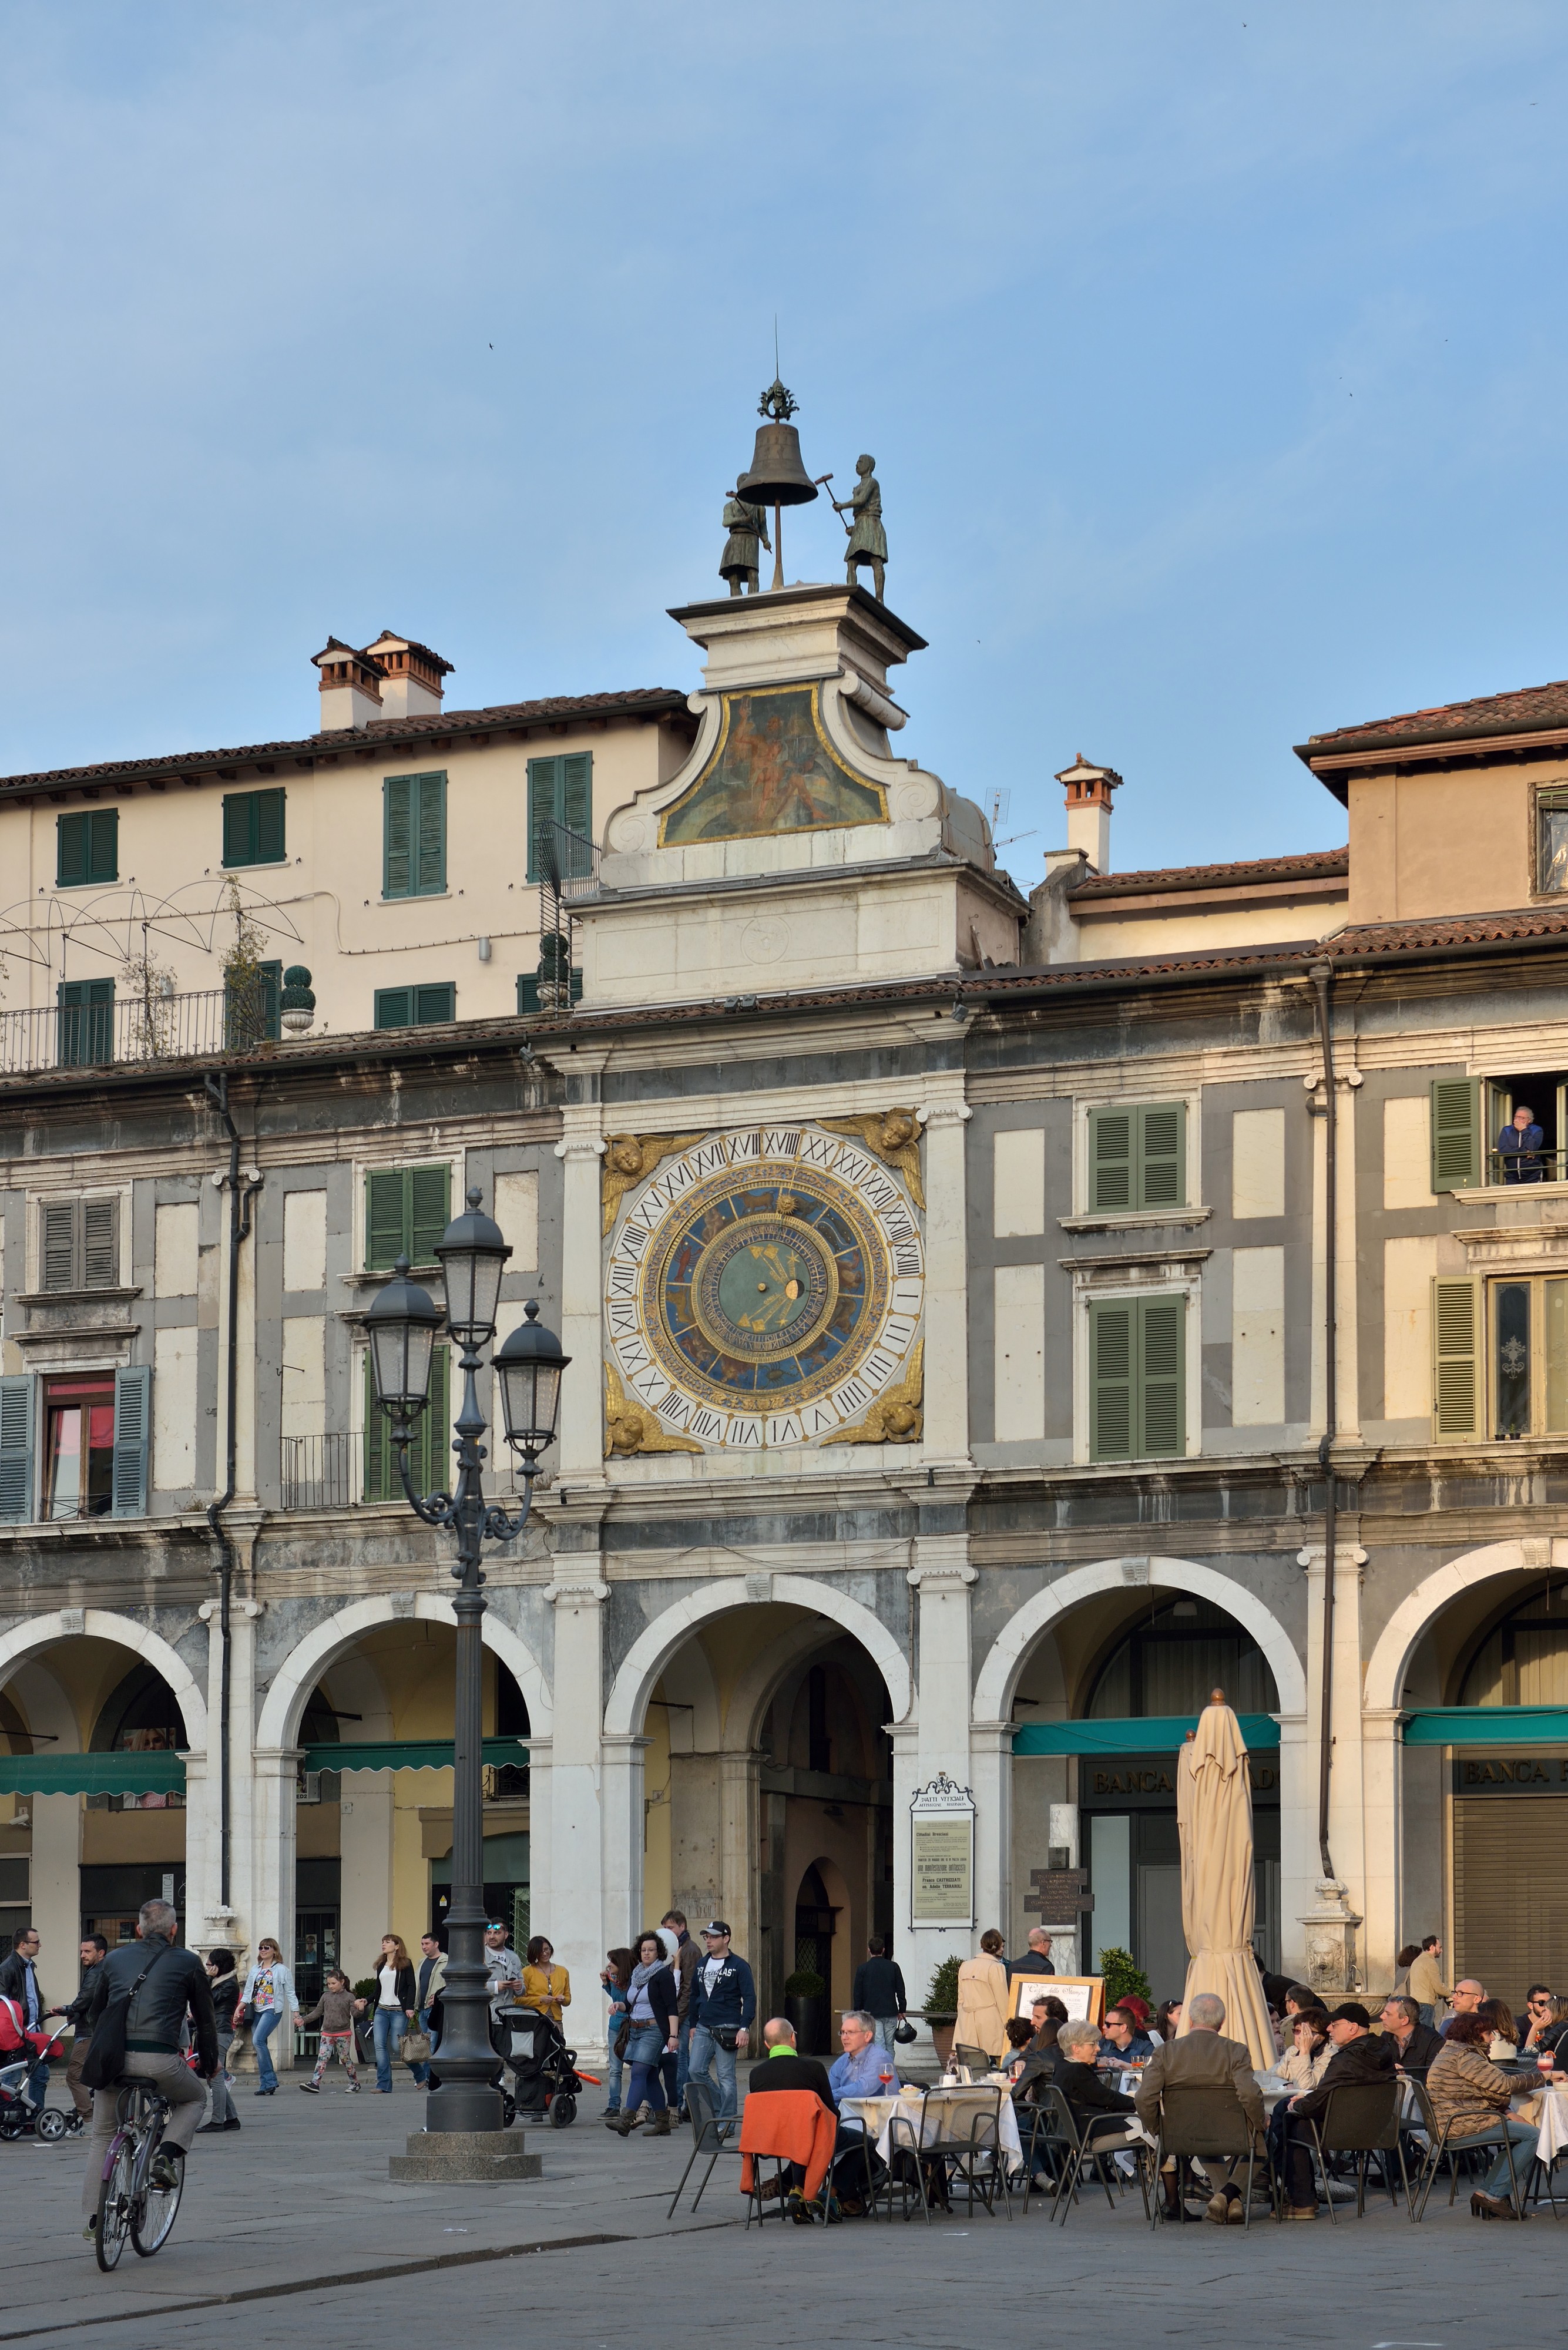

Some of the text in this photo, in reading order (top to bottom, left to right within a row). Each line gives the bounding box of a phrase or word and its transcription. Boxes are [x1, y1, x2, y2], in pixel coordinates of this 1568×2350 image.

[727, 1133, 761, 1160] XVIII
[765, 1133, 800, 1155] XVIIII
[802, 1136, 835, 1164] XX
[691, 1142, 726, 1176] XVII
[833, 1148, 869, 1181] XXI
[658, 1163, 694, 1198] XVI
[860, 1172, 895, 1208] XXII
[634, 1191, 664, 1227] XV
[881, 1203, 913, 1241] XXIII
[617, 1226, 647, 1261] XIIII
[894, 1238, 920, 1275] XXIIII
[612, 1266, 634, 1295] XIII
[612, 1304, 635, 1333] XII
[886, 1324, 910, 1344] II
[620, 1341, 647, 1369] XI
[865, 1355, 893, 1382] III
[639, 1372, 664, 1396] X
[837, 1382, 867, 1413] IIII
[659, 1392, 690, 1426] VIIII
[815, 1409, 831, 1431] V
[692, 1411, 720, 1439] VIII
[732, 1421, 759, 1444] VII
[773, 1419, 797, 1442] VI
[1093, 1771, 1174, 1794] BANCA
[1465, 1760, 1550, 1784] BANCA
[1062, 1985, 1086, 1998] Stampa
